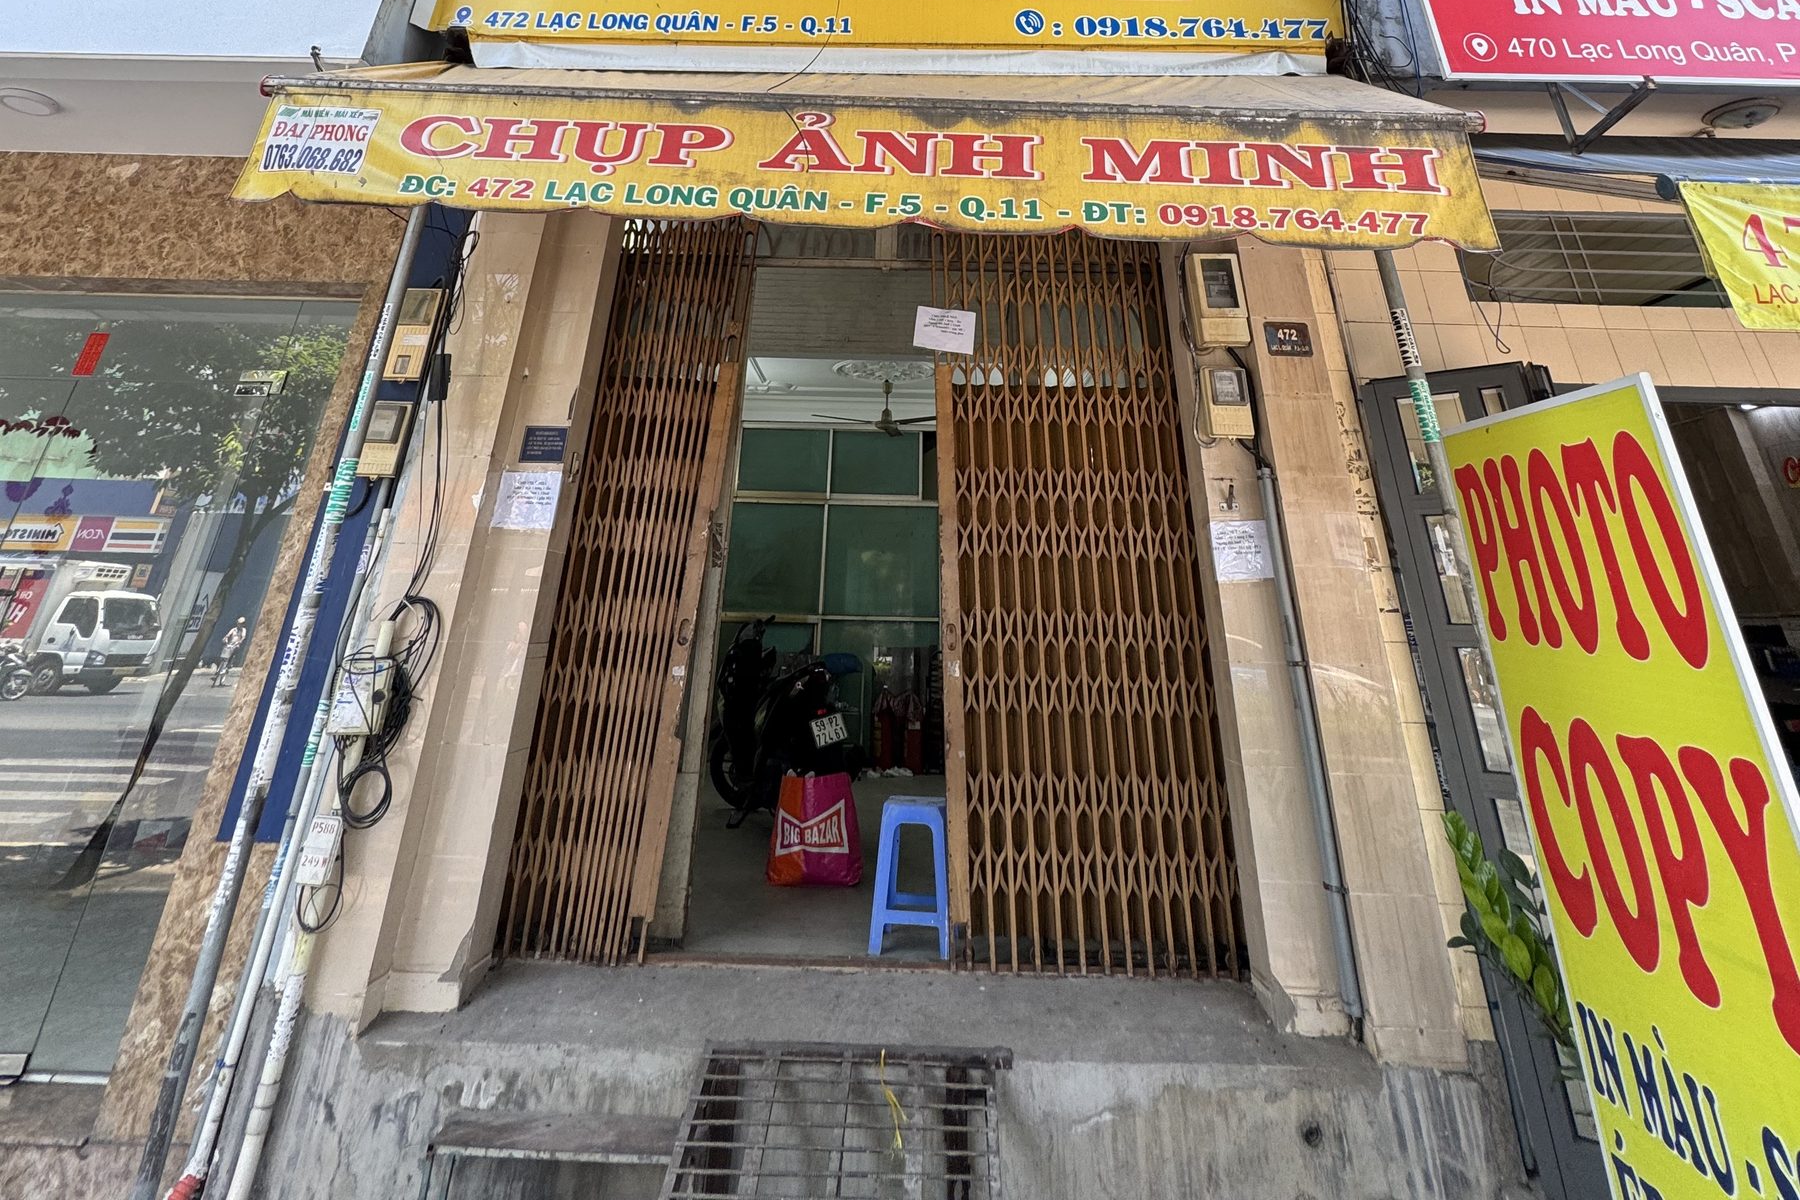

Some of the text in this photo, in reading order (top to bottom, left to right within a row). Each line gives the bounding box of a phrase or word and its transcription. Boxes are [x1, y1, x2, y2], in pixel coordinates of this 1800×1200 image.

[484, 11, 529, 29] 472
[535, 11, 582, 32] LẠC
[587, 13, 649, 31] LONG
[654, 11, 719, 34] QUÂN
[741, 15, 778, 33] F.5
[800, 15, 852, 35] Q.11
[1073, 15, 1329, 40] 0918.764.477
[1507, 37, 1556, 58] 470
[1562, 38, 1613, 64] Lạc
[1616, 38, 1687, 66] Long
[1691, 41, 1773, 65] Quân,
[272, 121, 370, 142] ĐẠI PHONG
[263, 144, 363, 173] 0763.068.682
[400, 112, 1452, 196] CHỤP ẢNH MINH
[399, 174, 457, 198] ĐC:
[466, 176, 536, 200] 472
[543, 180, 613, 208] LẠC
[623, 182, 723, 209] LONG
[728, 185, 829, 214] QUÂN
[865, 193, 923, 217] F.5
[958, 197, 1044, 221] Q.11
[1081, 201, 1147, 225] ĐT:
[1158, 203, 1430, 236] 0918.764.477
[1753, 283, 1798, 308] LẠC
[1278, 329, 1297, 340] 472
[1455, 430, 1709, 670] PHOTO
[311, 821, 336, 834] P588
[783, 815, 841, 845] BIG BAZAR
[1520, 704, 1800, 1055] COPY
[1576, 1001, 1631, 1118] IN
[1622, 1024, 1735, 1196] MÀU
